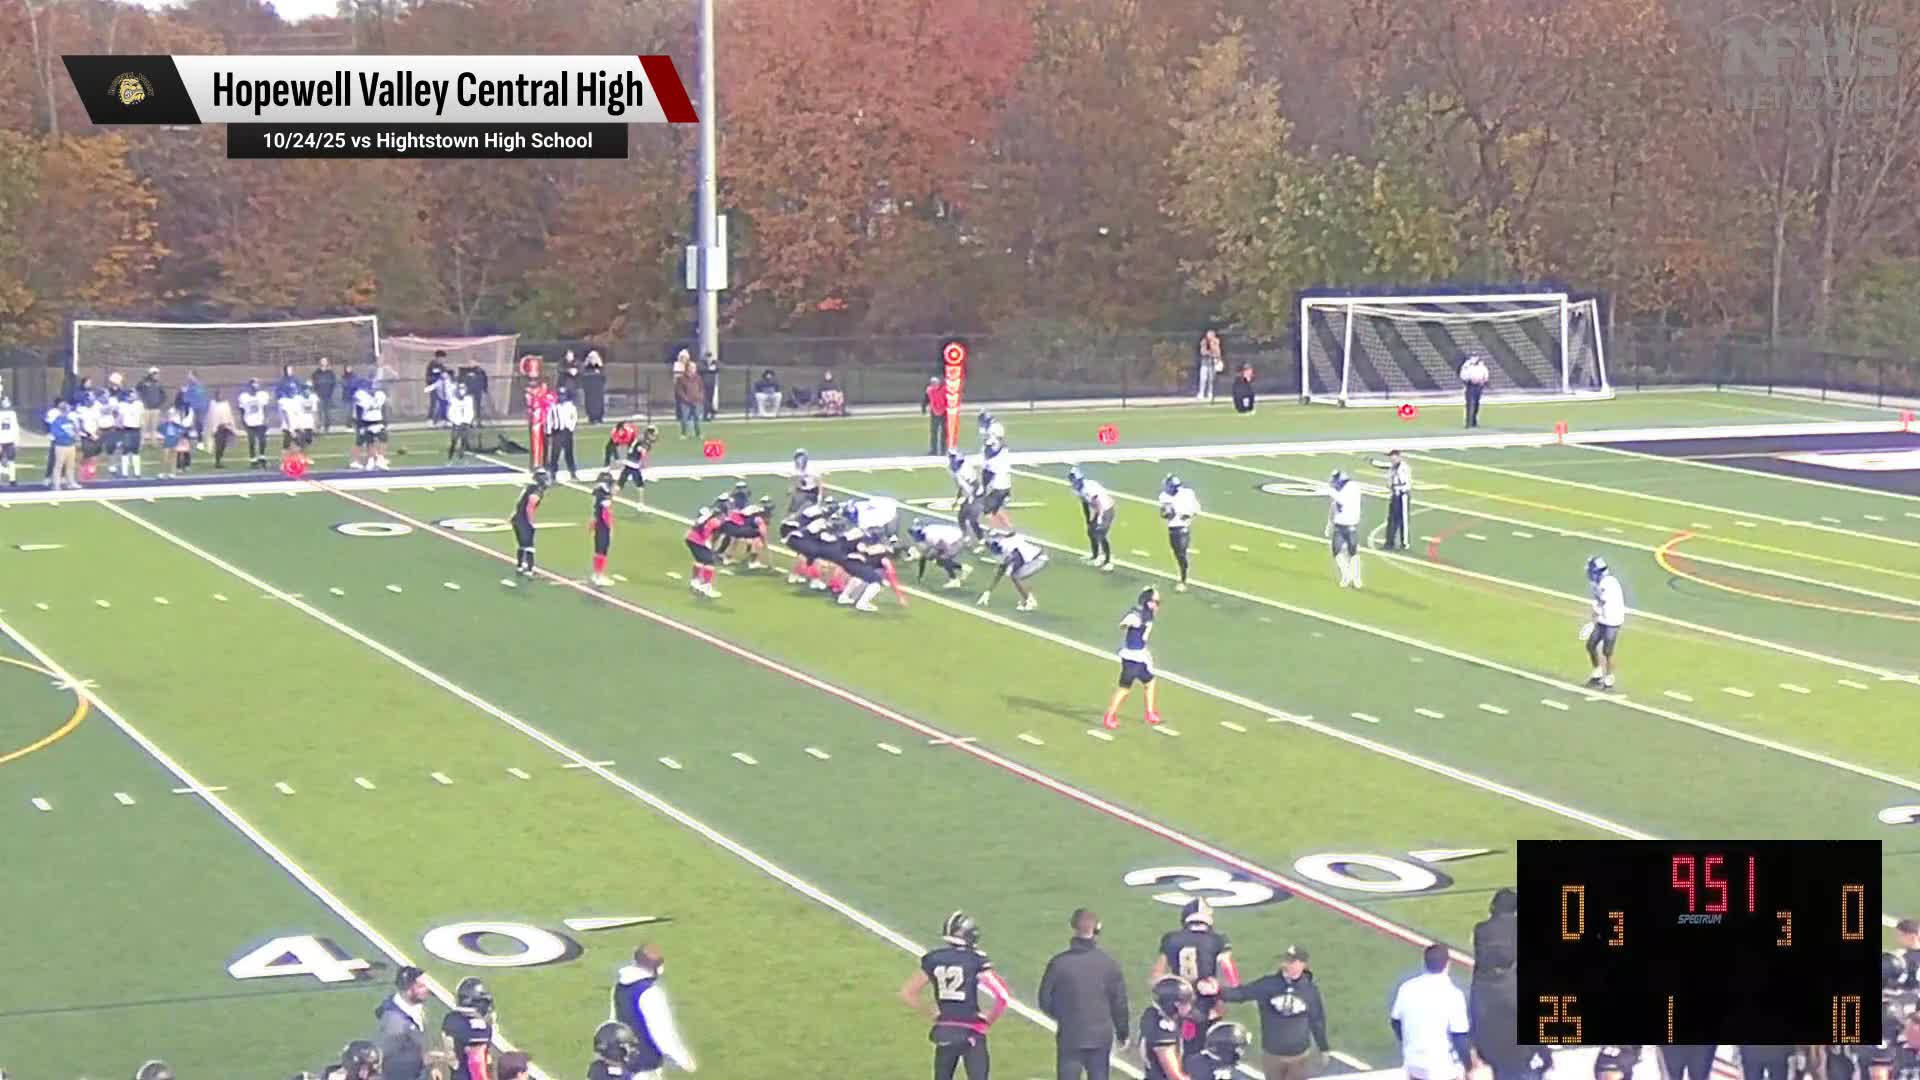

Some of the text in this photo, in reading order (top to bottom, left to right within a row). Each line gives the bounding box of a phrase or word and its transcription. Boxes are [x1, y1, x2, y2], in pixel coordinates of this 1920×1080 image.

[1562, 884, 1585, 940] 0
[1608, 911, 1624, 946] 3
[1677, 914, 1722, 924] SPECTRUM
[1776, 911, 1792, 946] 3
[1842, 884, 1864, 940] 0
[933, 965, 966, 1001] 12
[1178, 947, 1198, 980] 8
[1539, 995, 1582, 1043] 25
[1667, 995, 1674, 1043] 1
[1832, 995, 1861, 1043] 10
